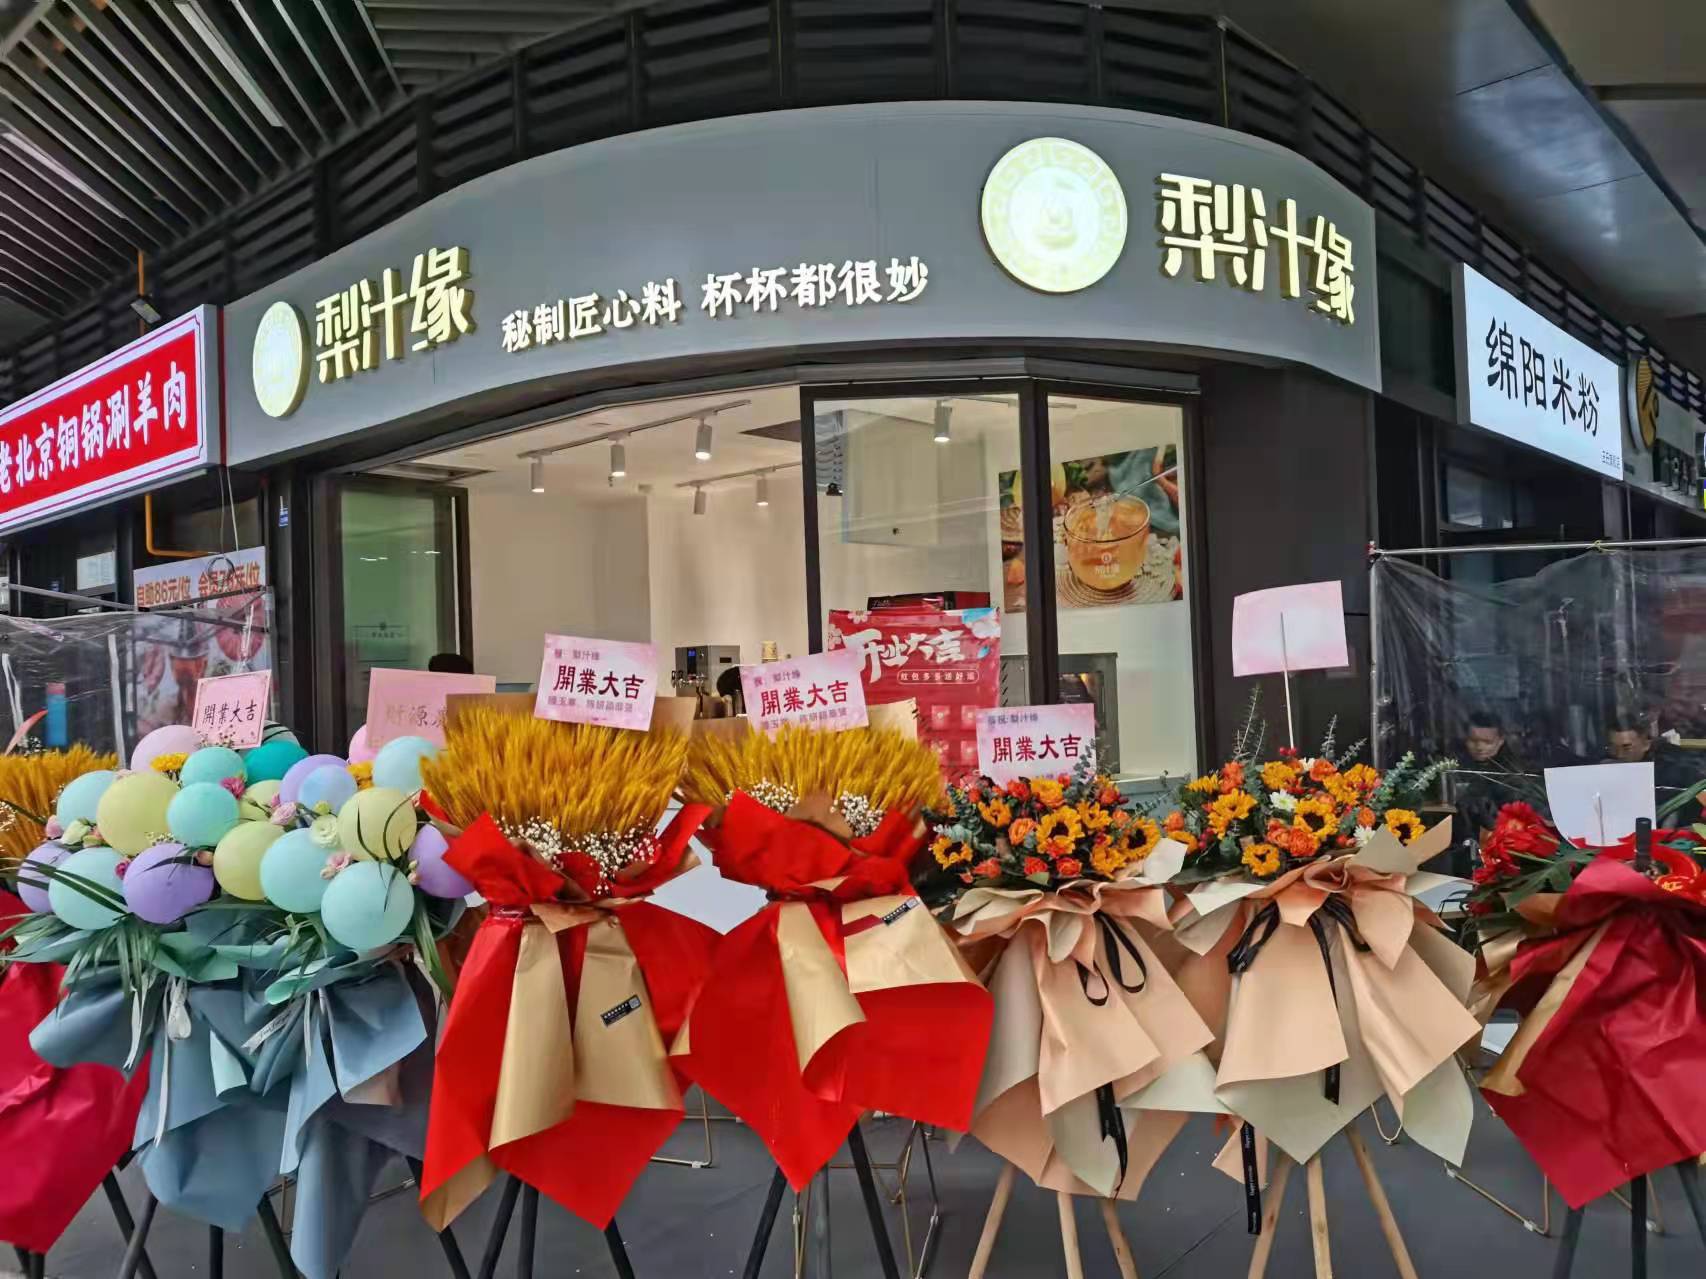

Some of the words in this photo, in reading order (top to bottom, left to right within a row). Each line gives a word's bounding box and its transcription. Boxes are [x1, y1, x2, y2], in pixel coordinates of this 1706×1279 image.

[1158, 172, 1355, 325] 梨汁缘
[315, 246, 474, 383] 梨汁缘
[501, 277, 682, 352] 秘制匠心料
[701, 256, 929, 318] 杯杯都很妙
[1485, 316, 1600, 437] 绵阳米粉
[0, 360, 187, 494] 老北京铜锅涮羊肉
[203, 698, 257, 726] 開業大吉
[553, 665, 644, 699] 開業大吉
[760, 680, 848, 717] 開業大吉
[992, 733, 1082, 763] 開業大吉
